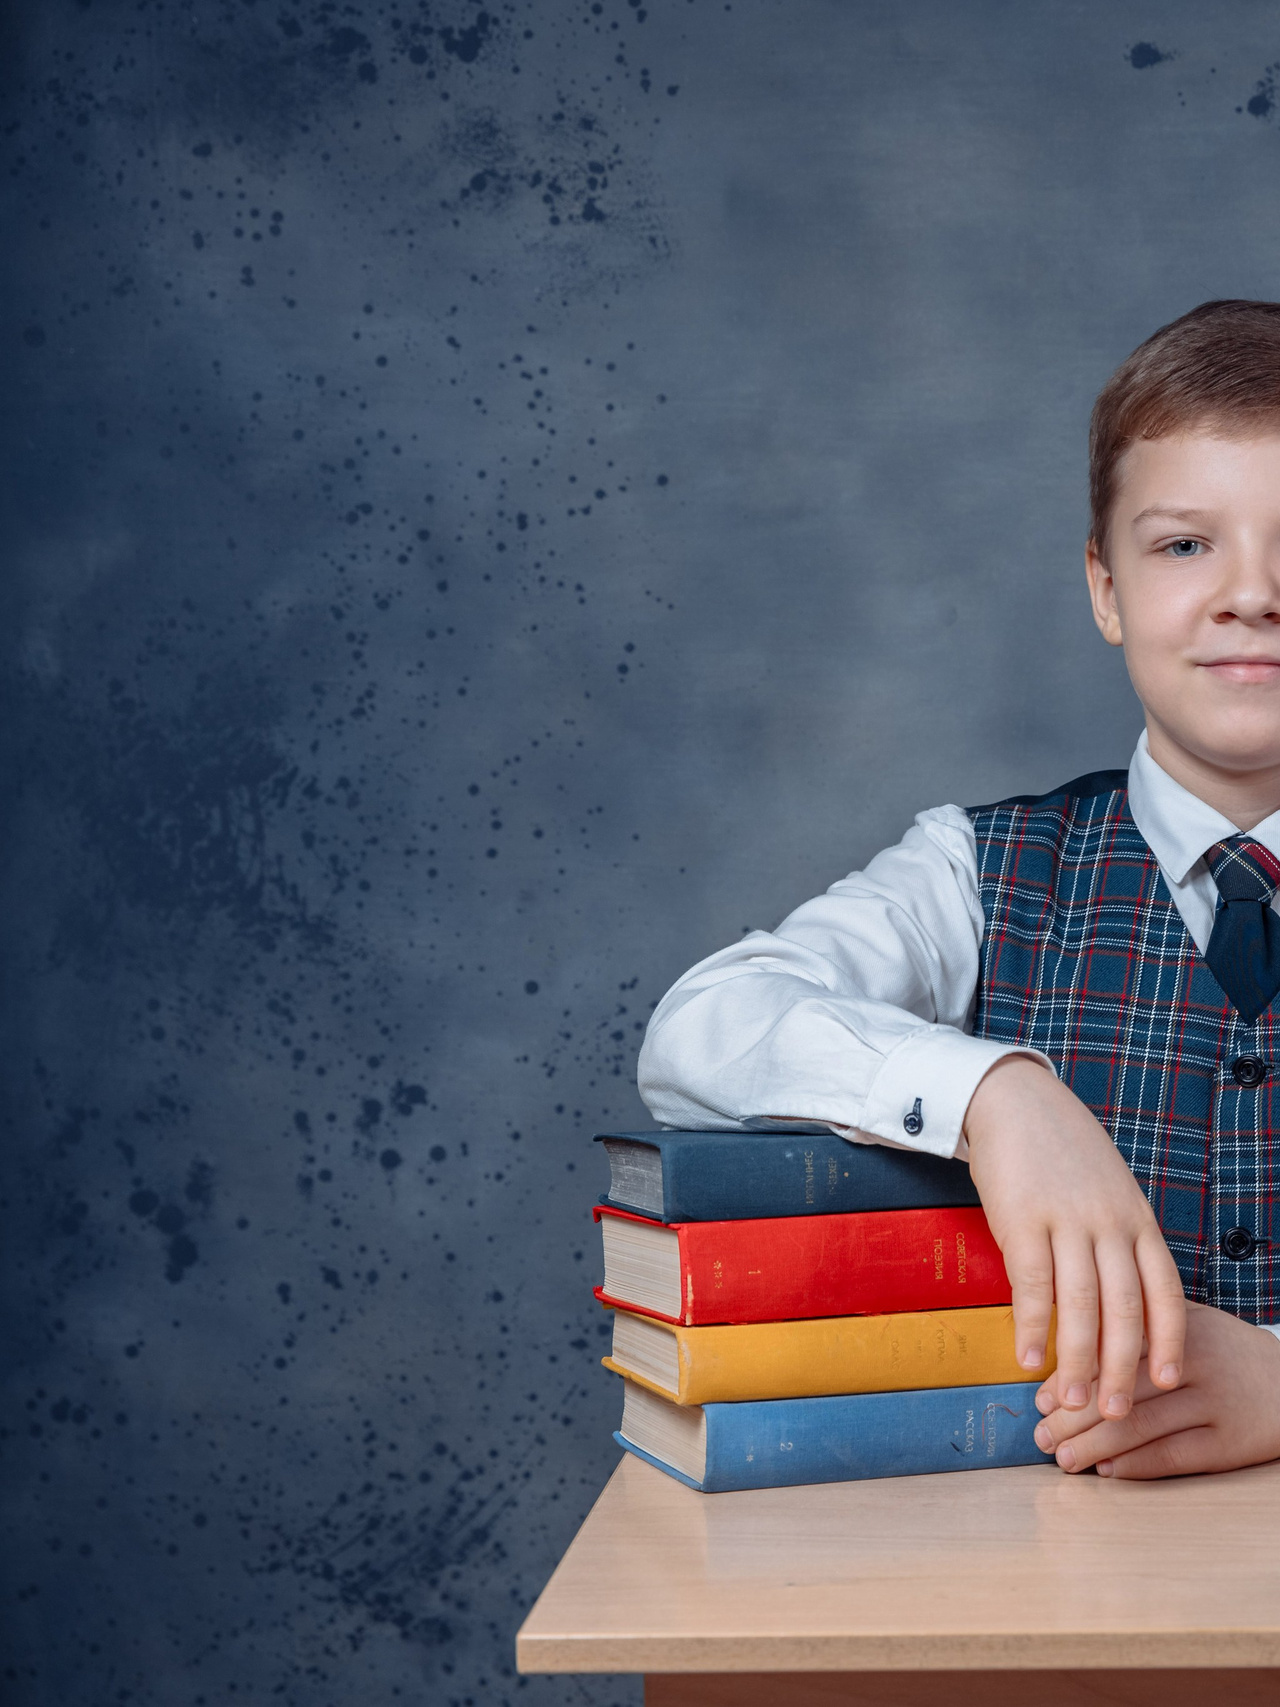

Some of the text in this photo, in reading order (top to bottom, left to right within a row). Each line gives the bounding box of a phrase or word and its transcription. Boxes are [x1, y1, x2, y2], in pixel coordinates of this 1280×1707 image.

[933, 1238, 944, 1281] ПОЭЗИЯ
[956, 1231, 967, 1284] СОВЕТСКАЯ
[780, 1442, 793, 1452] 2
